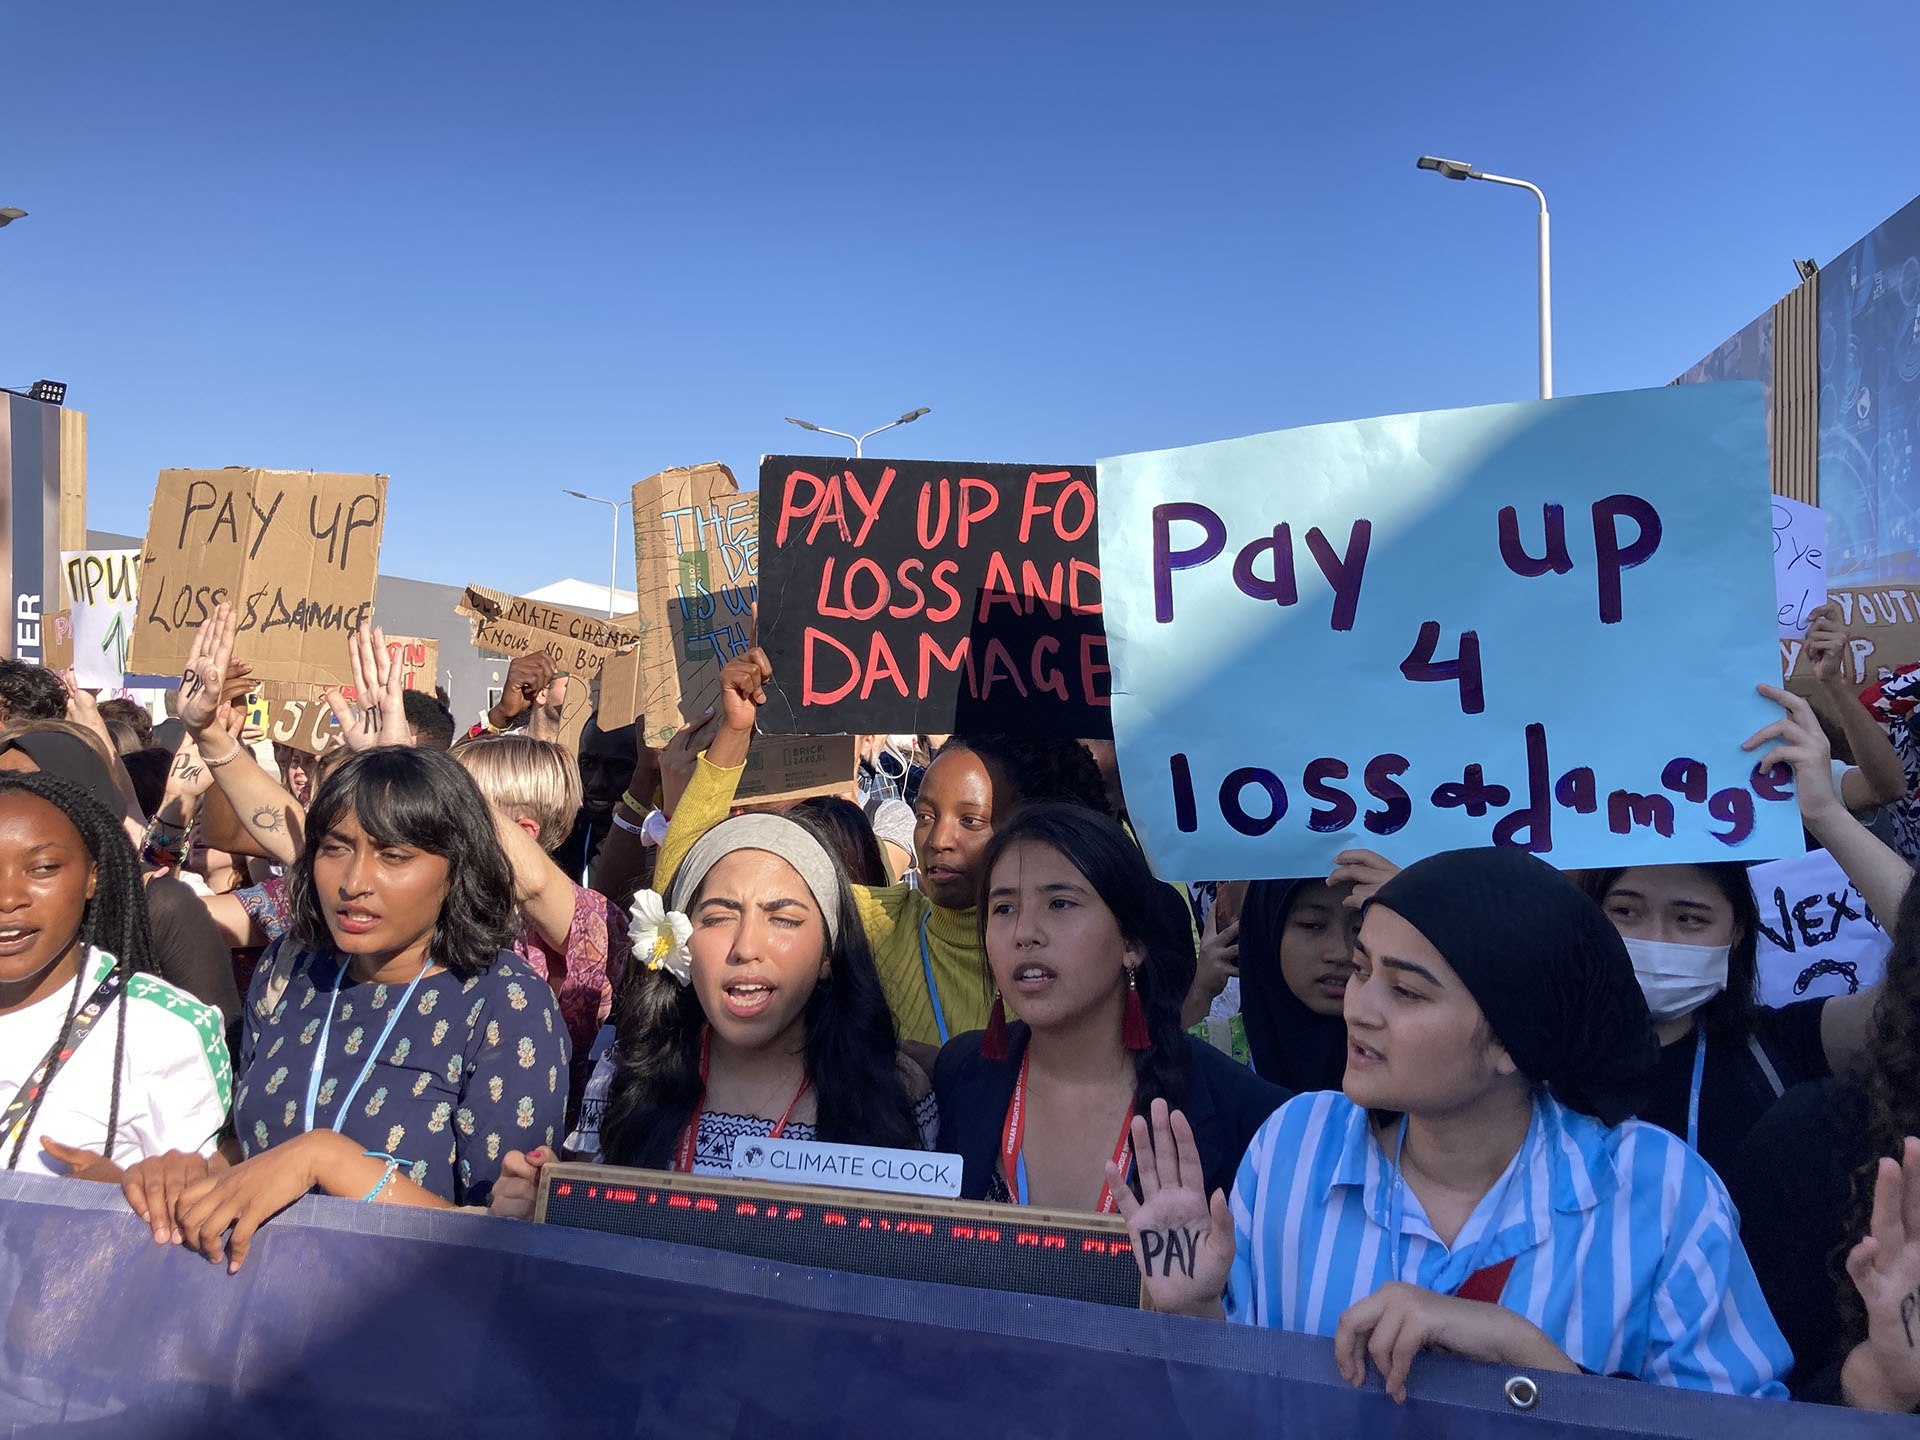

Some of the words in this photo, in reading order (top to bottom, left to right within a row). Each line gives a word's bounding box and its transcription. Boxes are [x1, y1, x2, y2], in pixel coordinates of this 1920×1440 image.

[178, 481, 284, 560] PAY
[310, 494, 379, 570] UP
[660, 500, 755, 556] THE
[776, 466, 896, 548] PAY
[917, 478, 999, 549] UP
[67, 554, 142, 606] ПРИ
[817, 556, 962, 623] LOSS
[978, 551, 1103, 624] AND
[1152, 502, 1372, 632] Pay
[1498, 494, 1662, 624] up
[803, 626, 1111, 706] DAMAGE
[1399, 621, 1485, 714] 4
[769, 1150, 865, 1177] CLIMATE
[872, 1159, 950, 1184] CLOCK
[1140, 1227, 1201, 1279] PAY
